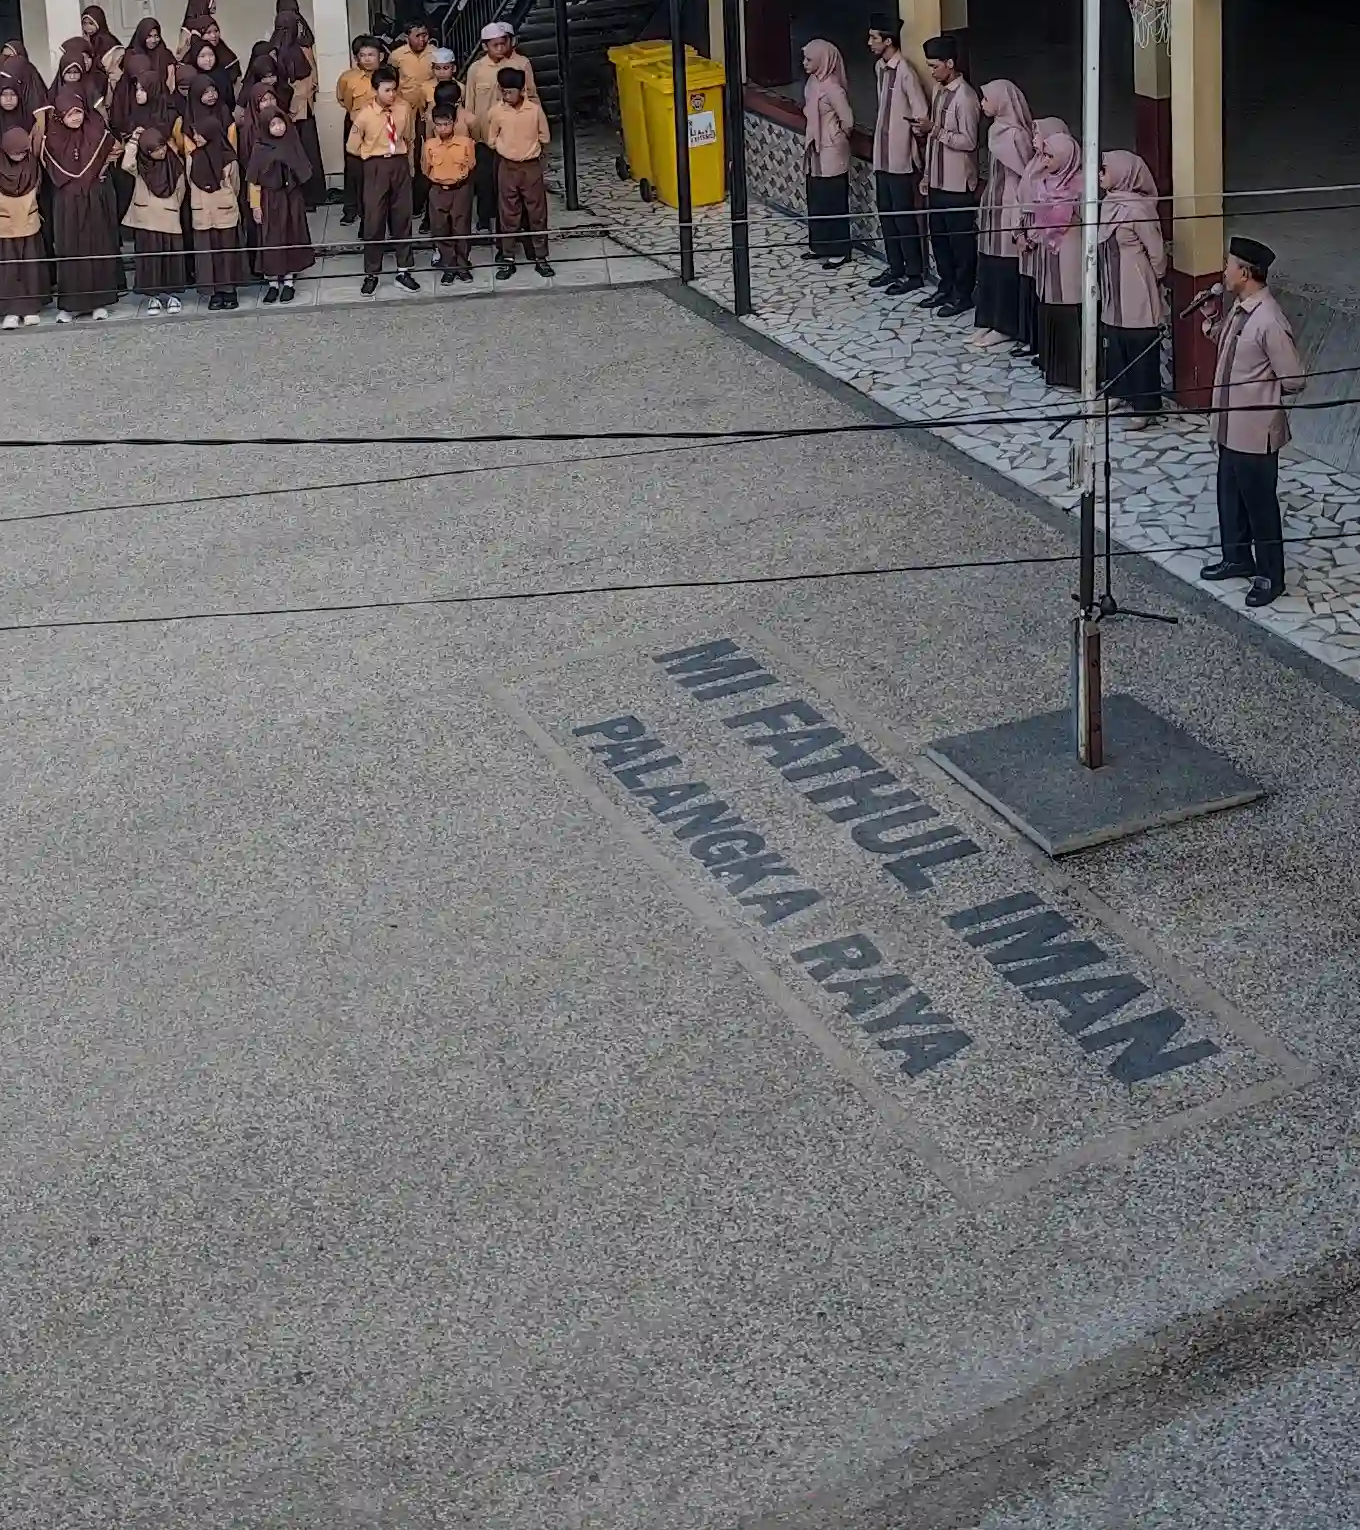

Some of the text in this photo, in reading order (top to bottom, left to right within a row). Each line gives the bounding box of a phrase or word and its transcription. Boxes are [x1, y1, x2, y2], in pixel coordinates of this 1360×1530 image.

[571, 714, 975, 1079] PALANGKA RAYA
[651, 637, 1223, 1085] MI FATHUL IMAN
